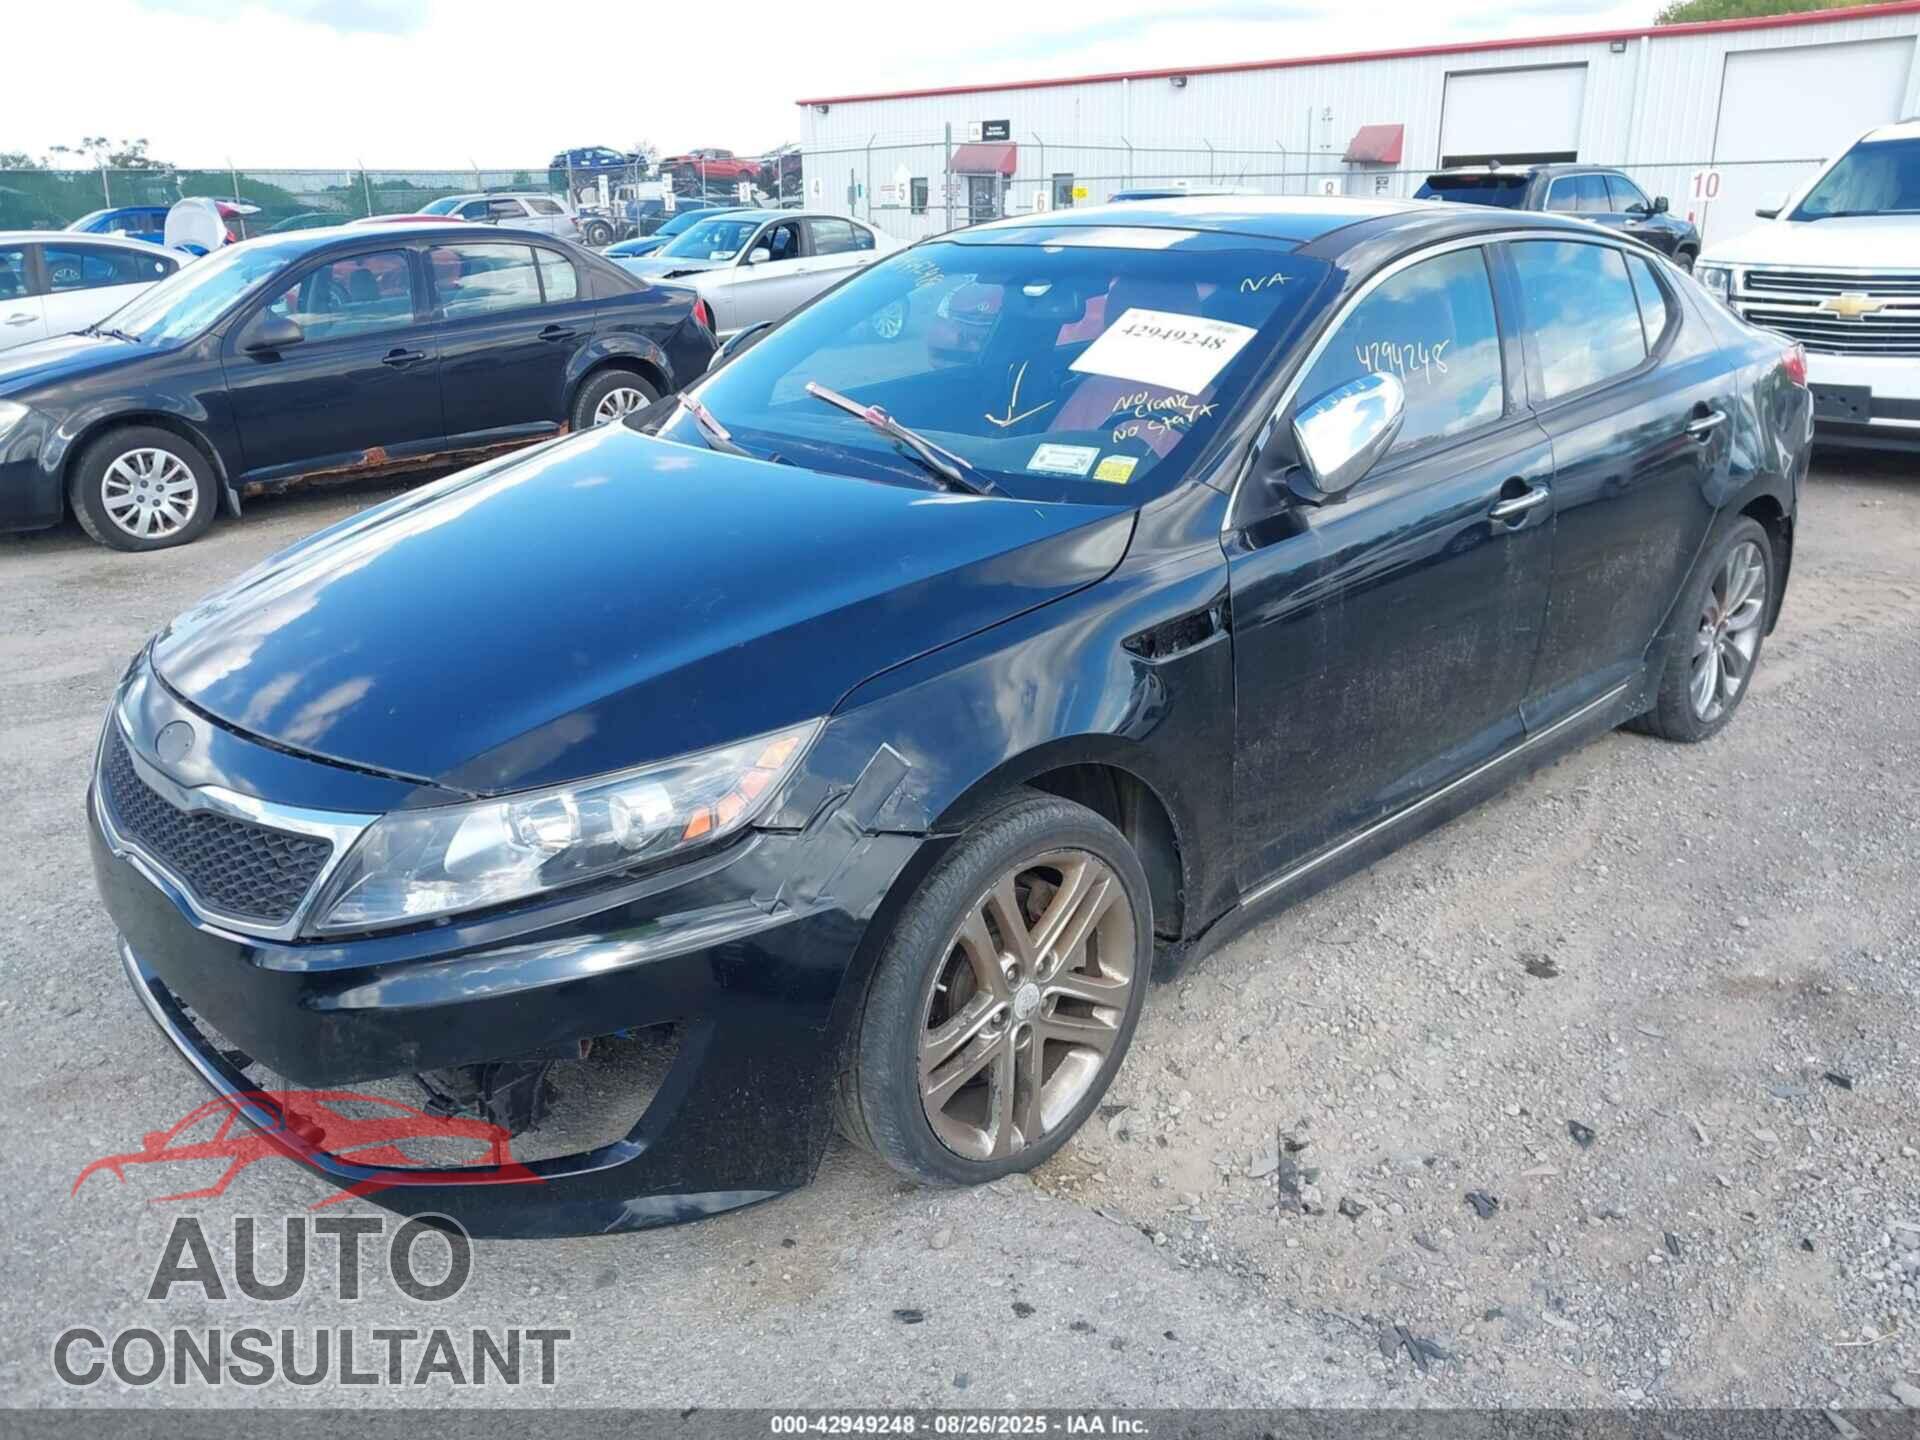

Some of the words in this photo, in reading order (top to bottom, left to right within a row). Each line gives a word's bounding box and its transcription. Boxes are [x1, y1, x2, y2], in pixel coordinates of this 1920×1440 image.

[898, 183, 905, 200] 5
[1693, 172, 1720, 198] 10
[1037, 192, 1045, 212] 6
[1240, 273, 1293, 293] NA
[1121, 323, 1227, 350] 42949248
